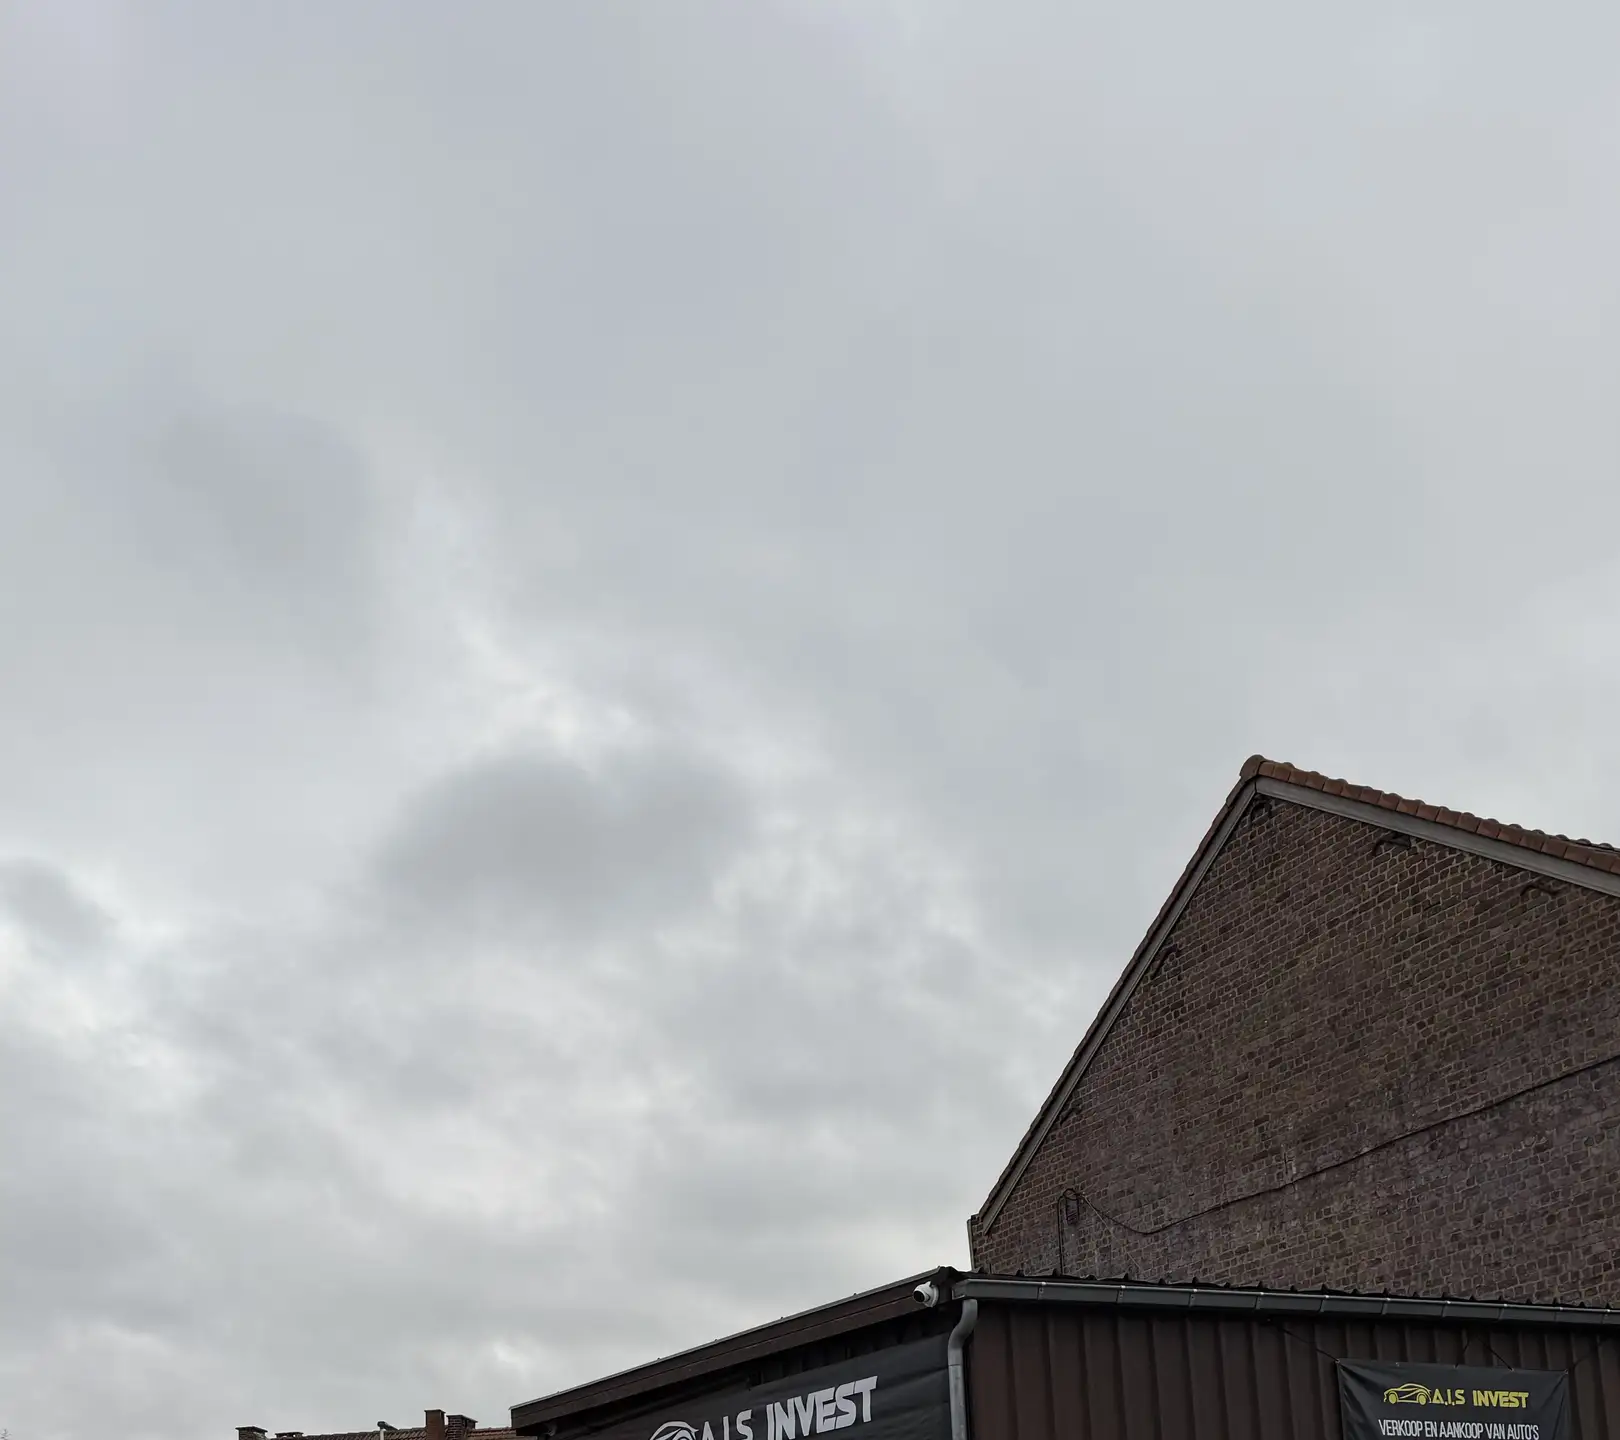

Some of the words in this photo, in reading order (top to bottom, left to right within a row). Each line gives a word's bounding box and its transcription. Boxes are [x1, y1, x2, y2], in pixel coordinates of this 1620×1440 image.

[1472, 1390, 1529, 1408] INVEST
[1378, 1419, 1423, 1437] VERKOOP
[1425, 1421, 1437, 1438] EN
[1439, 1421, 1484, 1439] AANKOOP
[1485, 1423, 1506, 1440] VAN
[1507, 1424, 1540, 1440] AUTO'S
